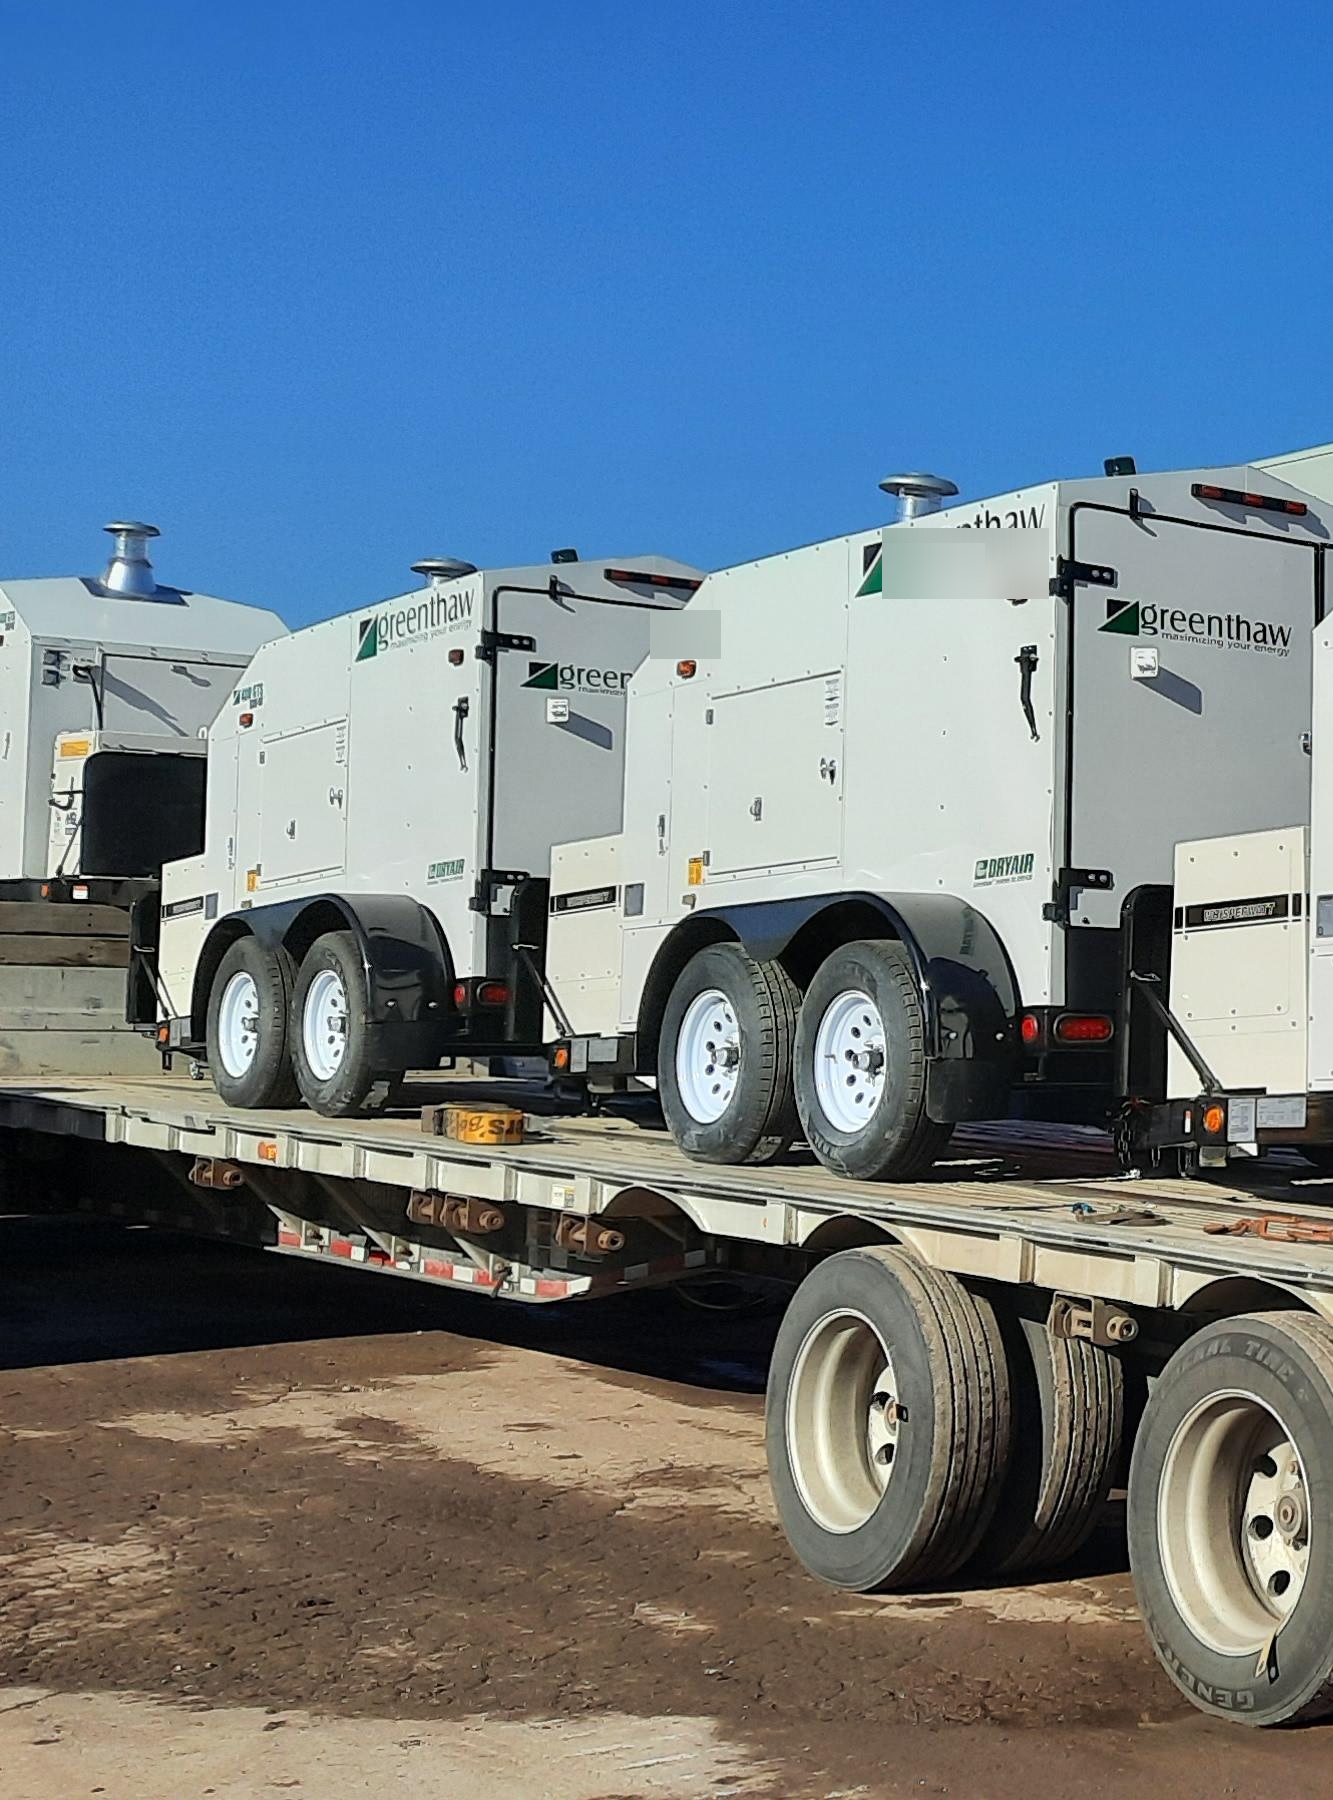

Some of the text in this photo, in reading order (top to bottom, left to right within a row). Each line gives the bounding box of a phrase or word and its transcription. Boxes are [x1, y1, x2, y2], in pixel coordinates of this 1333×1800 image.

[378, 588, 475, 652] greenthaw
[1140, 603, 1292, 647] greenthaw
[988, 852, 1035, 878] DRYAIR
